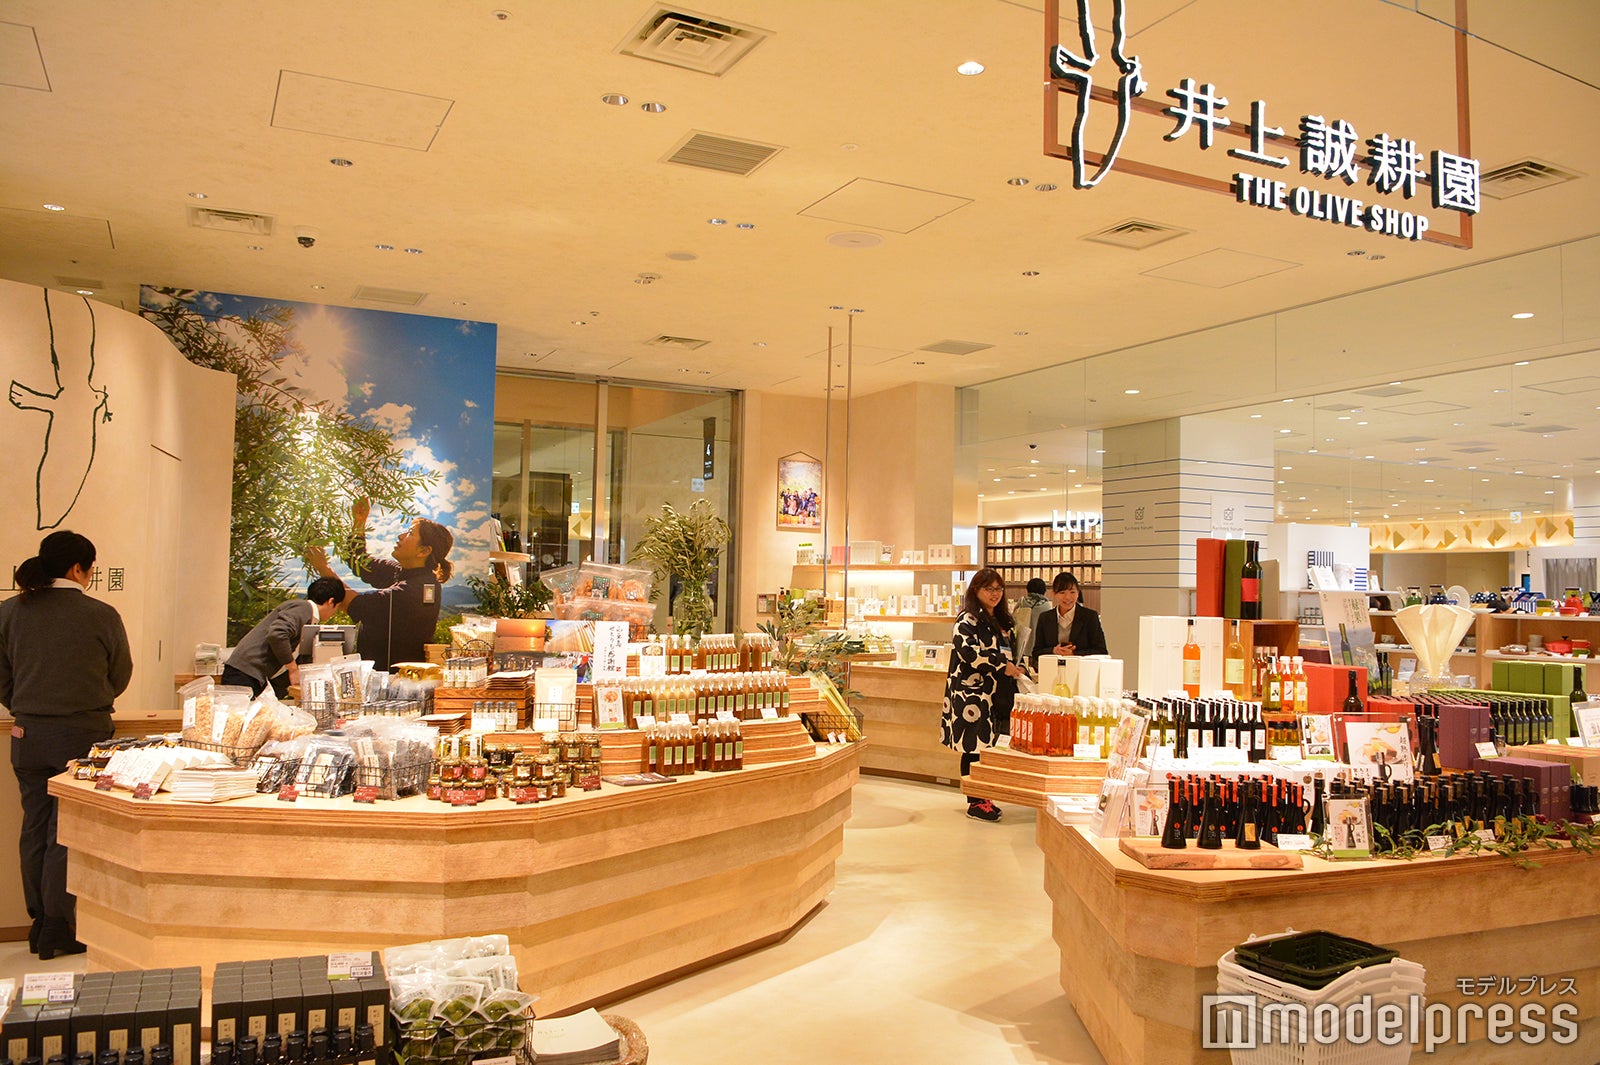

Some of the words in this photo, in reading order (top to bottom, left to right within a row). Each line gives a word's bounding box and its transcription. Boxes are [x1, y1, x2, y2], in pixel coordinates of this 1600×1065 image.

[1165, 78, 1480, 214] 井上誠耕園
[1236, 172, 1287, 210] THE
[1290, 185, 1363, 228] OLIVE
[1367, 205, 1430, 241] SHOP
[1052, 509, 1103, 533] LUP
